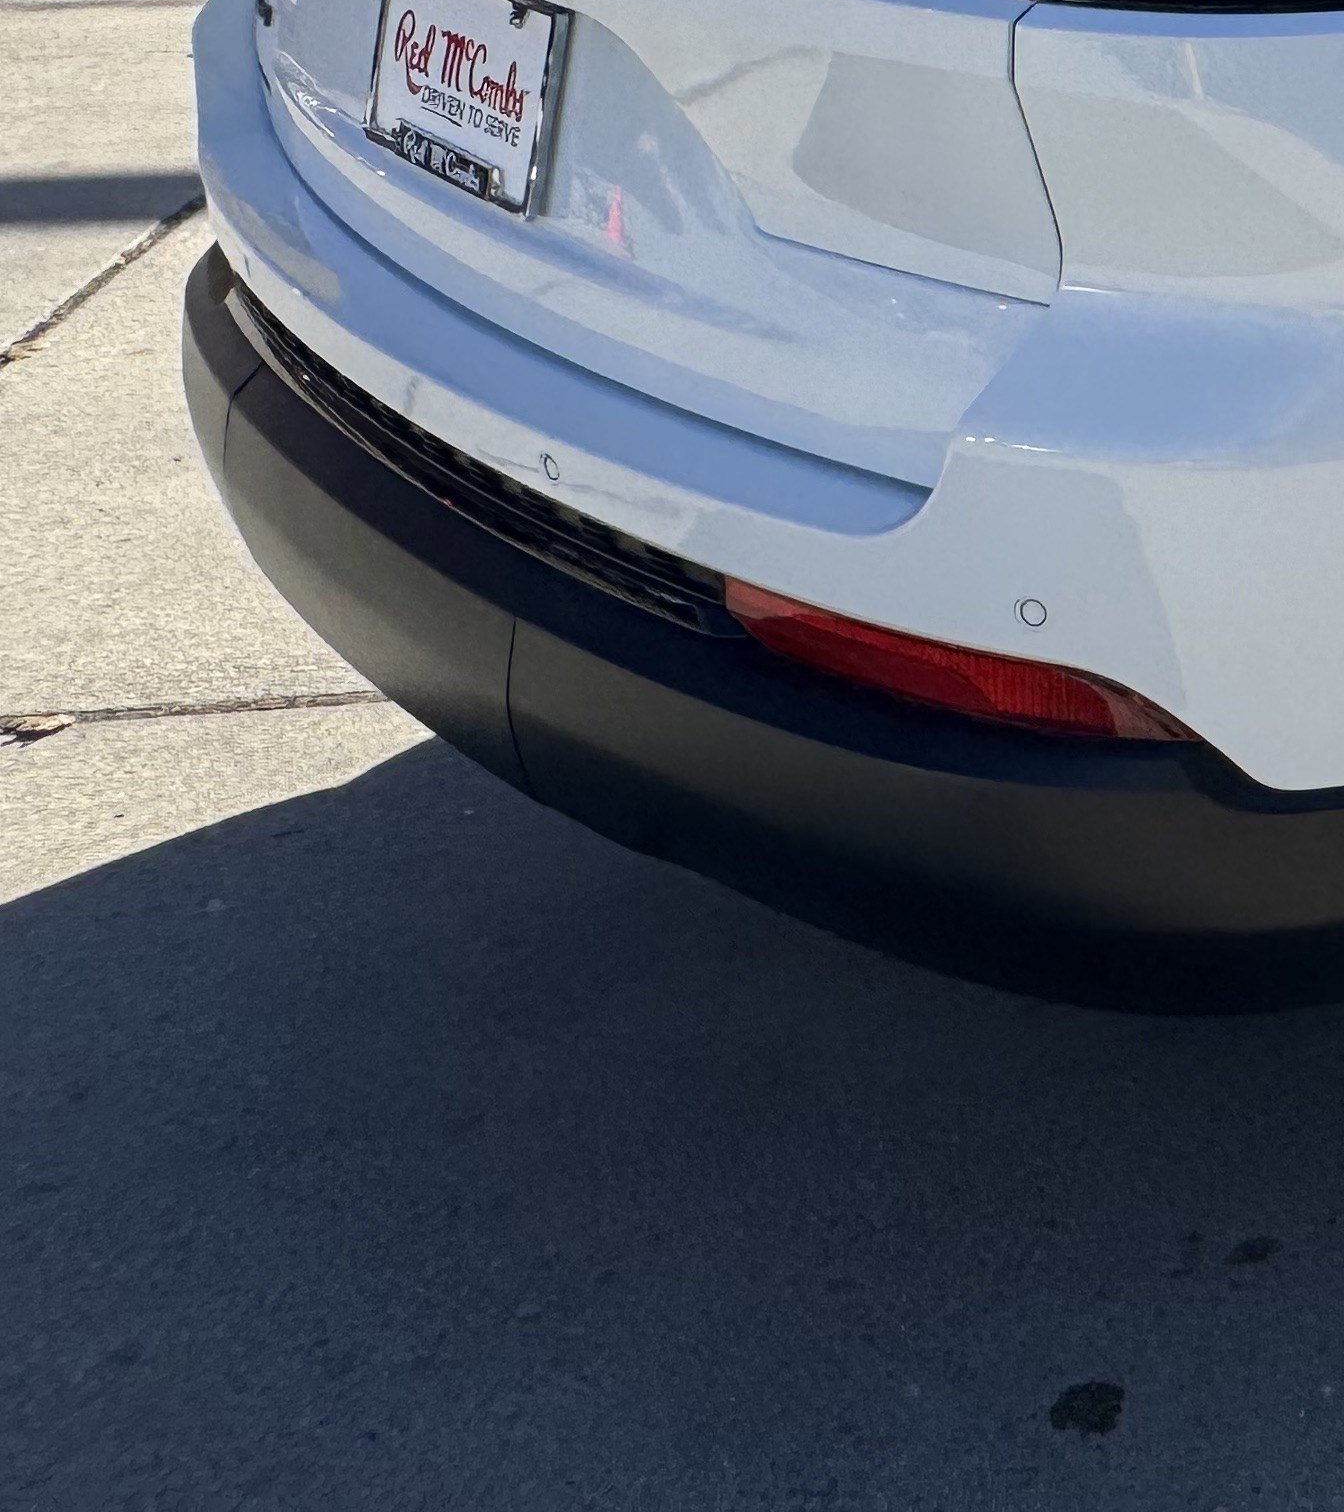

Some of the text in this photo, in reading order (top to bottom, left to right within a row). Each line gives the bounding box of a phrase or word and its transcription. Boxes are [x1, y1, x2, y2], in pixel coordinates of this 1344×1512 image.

[394, 9, 437, 96] Red
[421, 85, 465, 121] DRIVEN
[467, 104, 484, 129] TO
